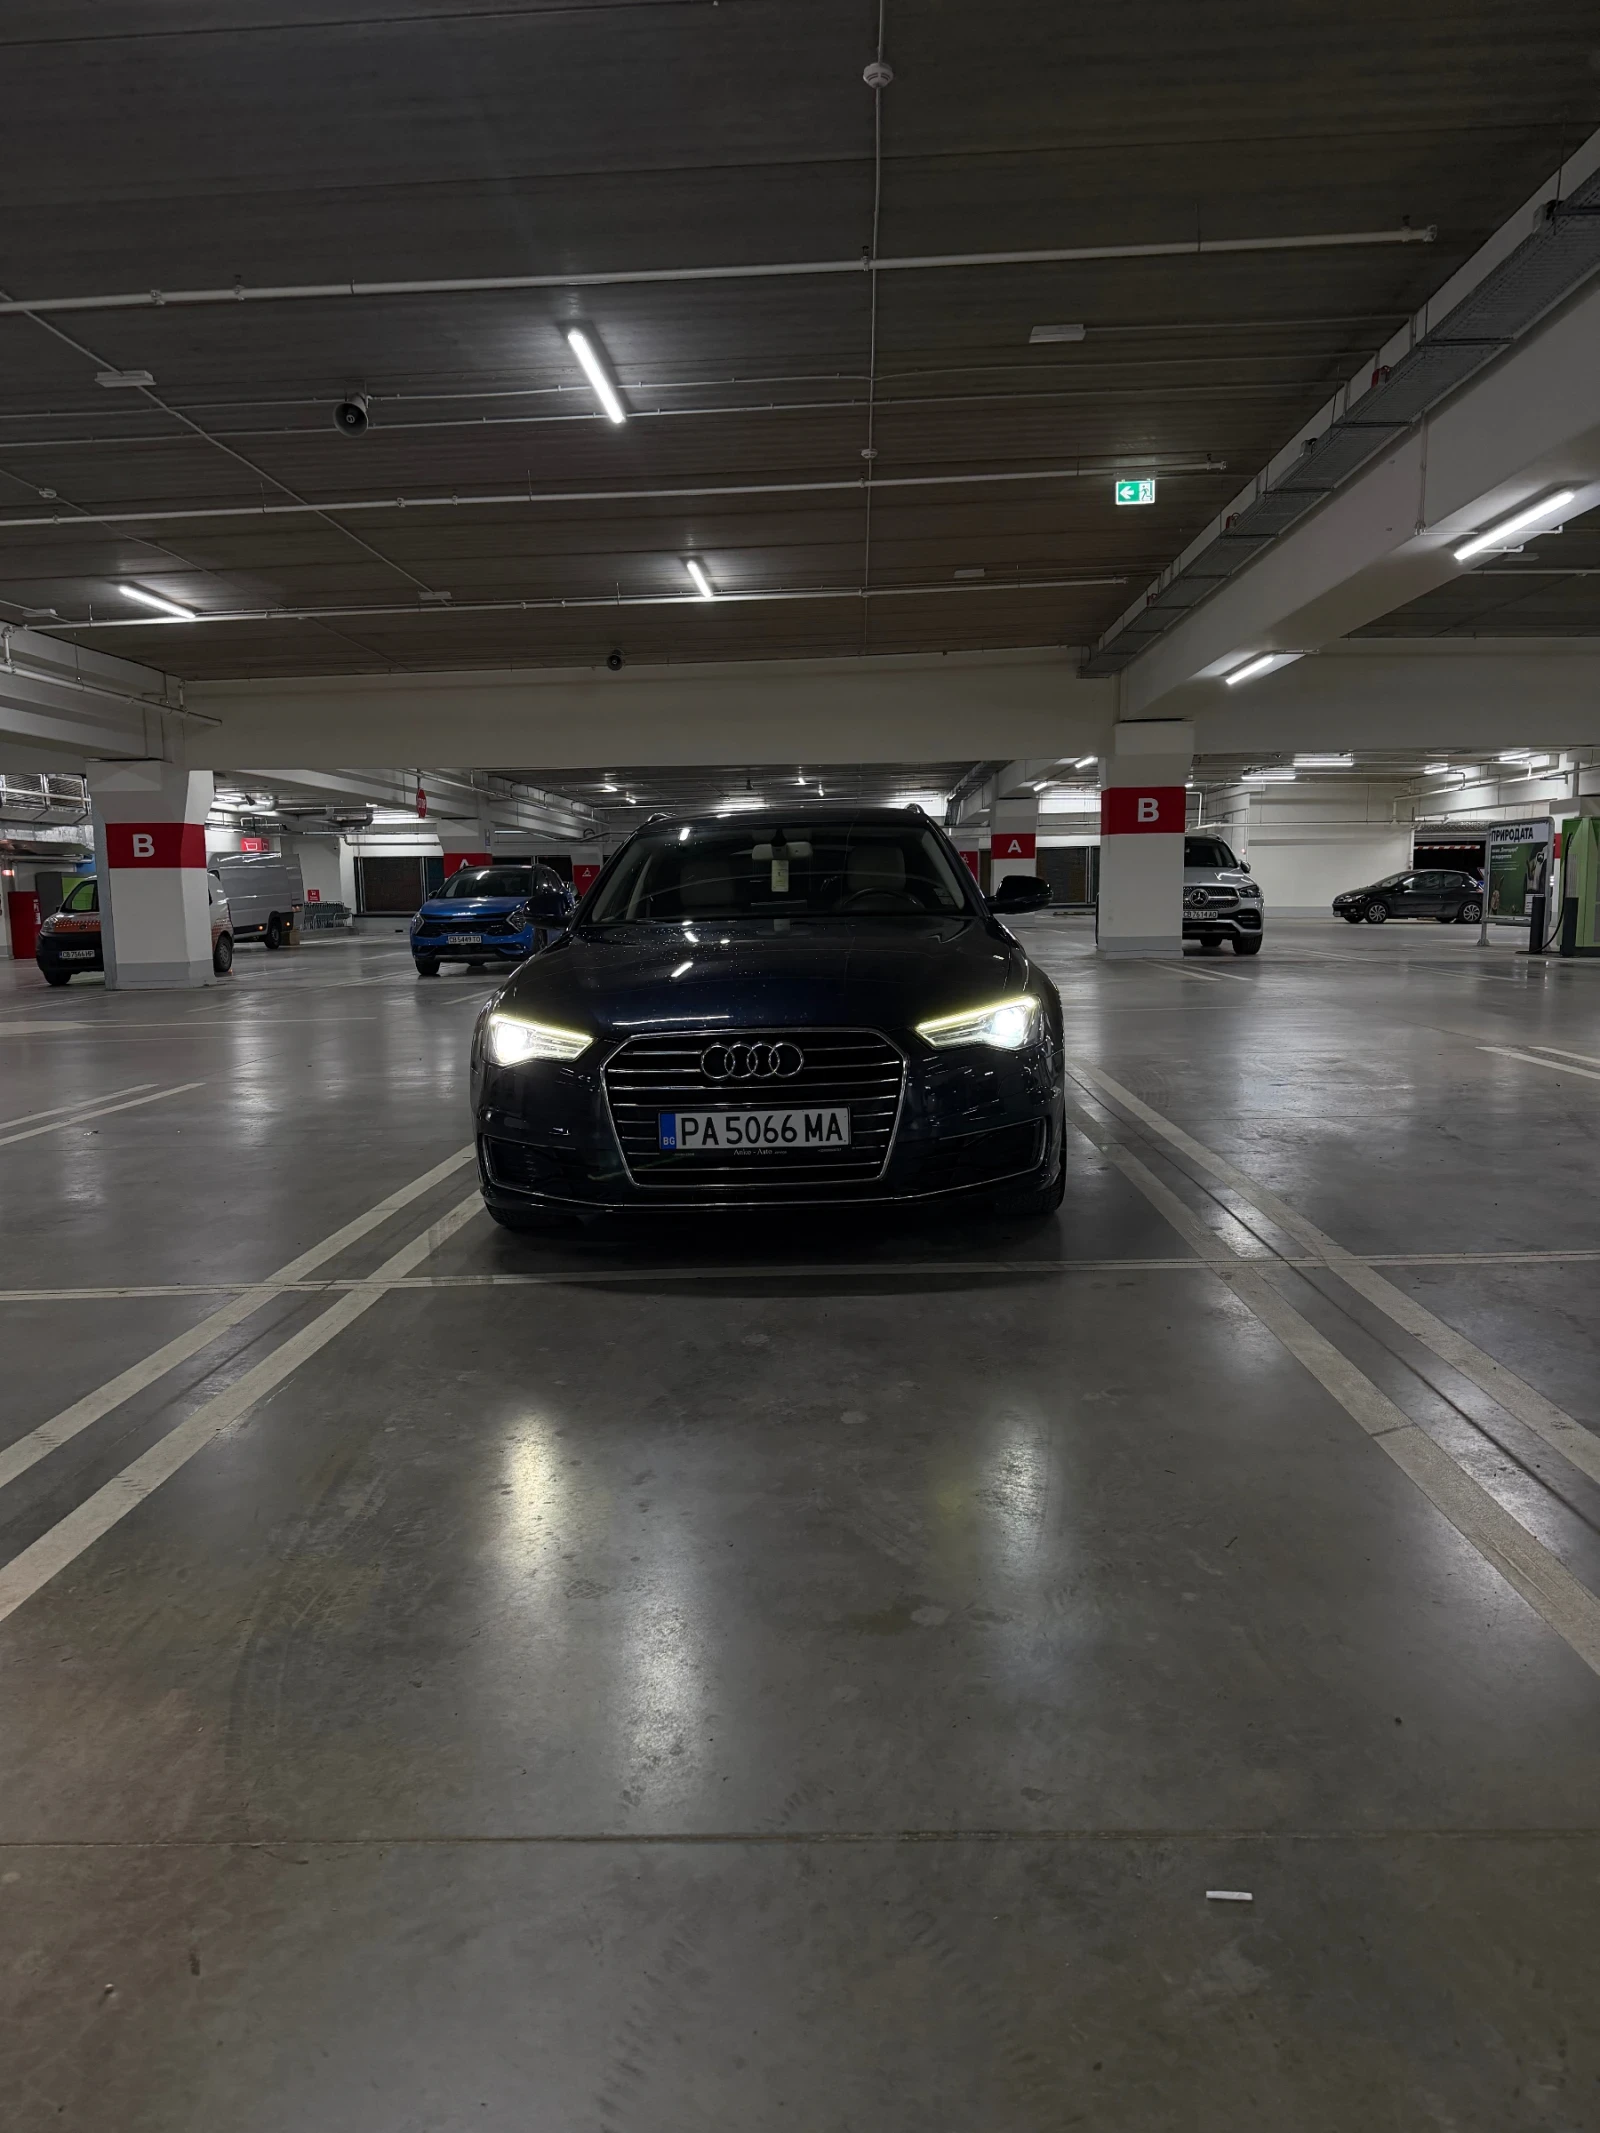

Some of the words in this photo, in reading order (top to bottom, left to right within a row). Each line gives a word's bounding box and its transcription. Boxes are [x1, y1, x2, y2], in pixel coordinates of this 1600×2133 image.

[1137, 797, 1160, 823] B
[1491, 827, 1534, 842] ПРИРОДАТА
[132, 833, 155, 858] B
[1007, 839, 1022, 853] A
[681, 1116, 719, 1146] PA
[726, 1114, 797, 1145] 5066
[805, 1112, 843, 1142] MA
[663, 1136, 676, 1146] BG
